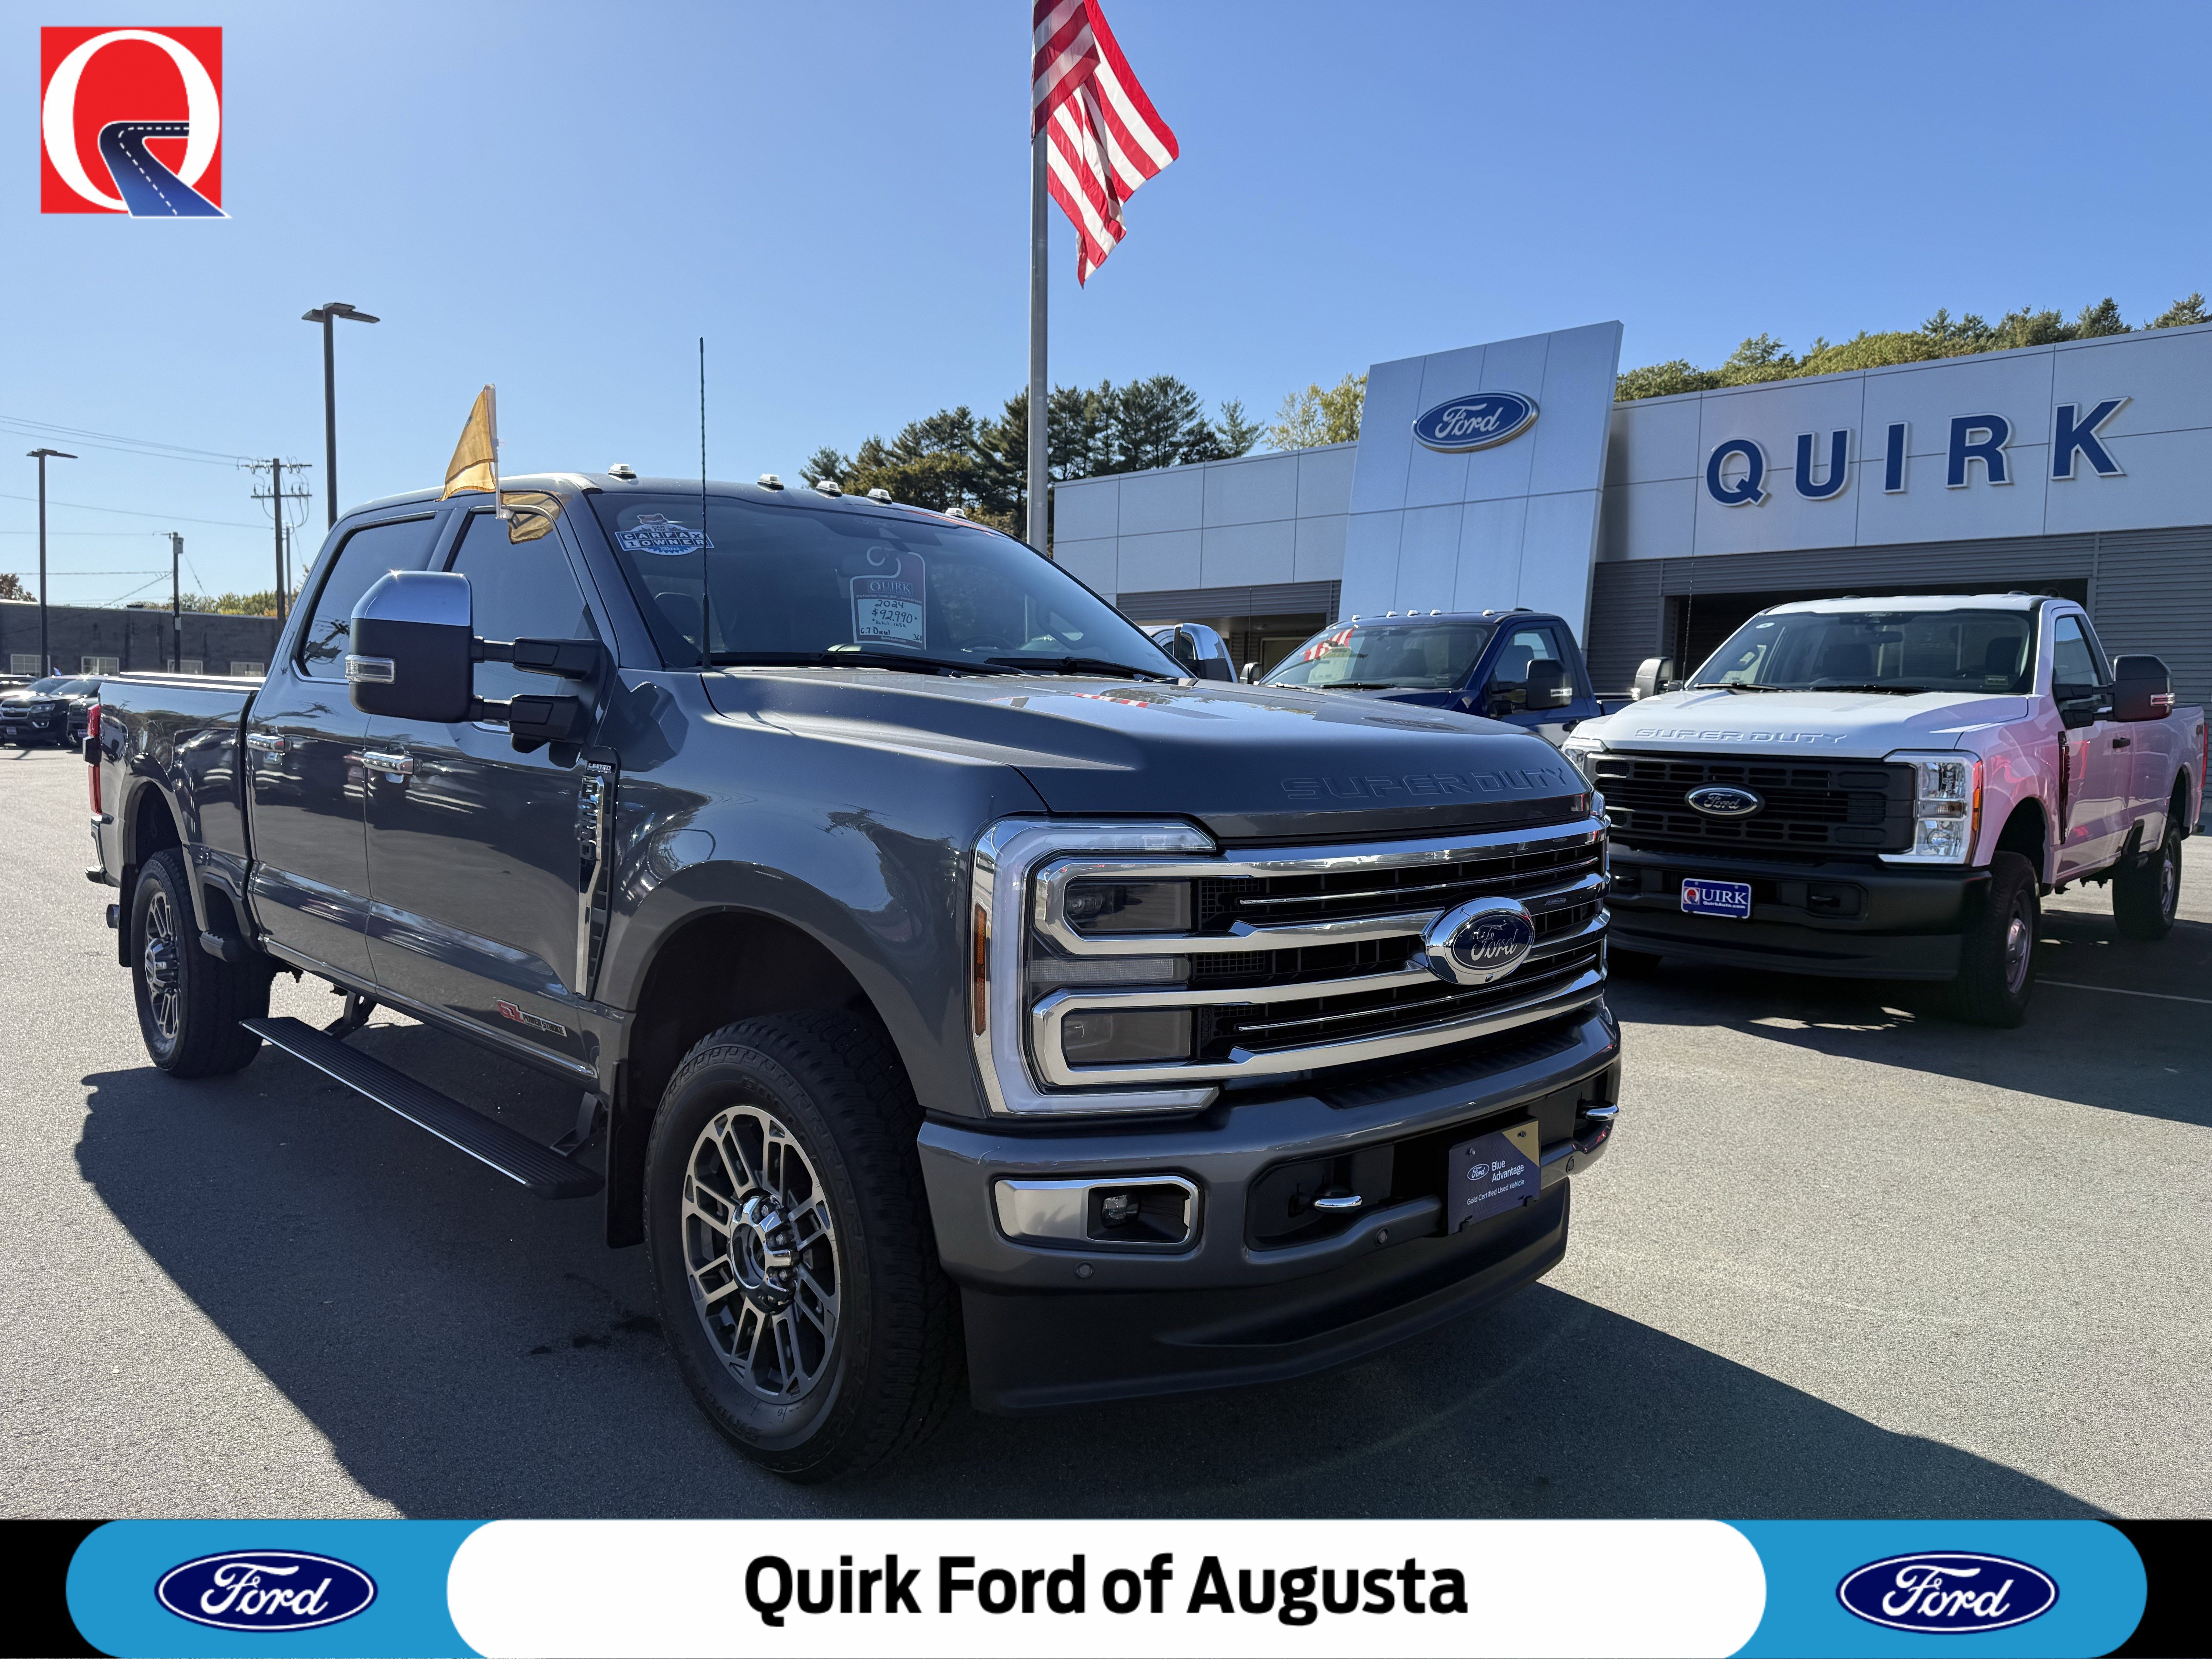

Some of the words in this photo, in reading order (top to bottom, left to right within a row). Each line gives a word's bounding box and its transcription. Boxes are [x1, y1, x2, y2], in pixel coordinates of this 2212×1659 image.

[1434, 403, 1504, 438] Ford
[1705, 396, 2133, 507] QUIRK
[870, 581, 910, 592] QUIRK
[875, 599, 904, 608] 2024
[1635, 728, 1745, 742] SUPER
[1749, 732, 1847, 744] DUTY
[1280, 773, 1473, 800] SUPER
[1471, 767, 1568, 792] DUTY
[1704, 792, 1741, 809] Ford
[1684, 887, 1748, 905] QUIRK
[1703, 901, 1746, 909] QuirkAuto.com
[1470, 919, 1518, 962] Ford
[1472, 1166, 1486, 1178] Ford
[1492, 1160, 1506, 1171] Blue
[1492, 1164, 1524, 1183] Advantage
[1467, 1195, 1478, 1205] Gold
[1478, 1188, 1497, 1201] Certified
[1498, 1184, 1509, 1194] Used
[1509, 1179, 1524, 1189] Vehicle
